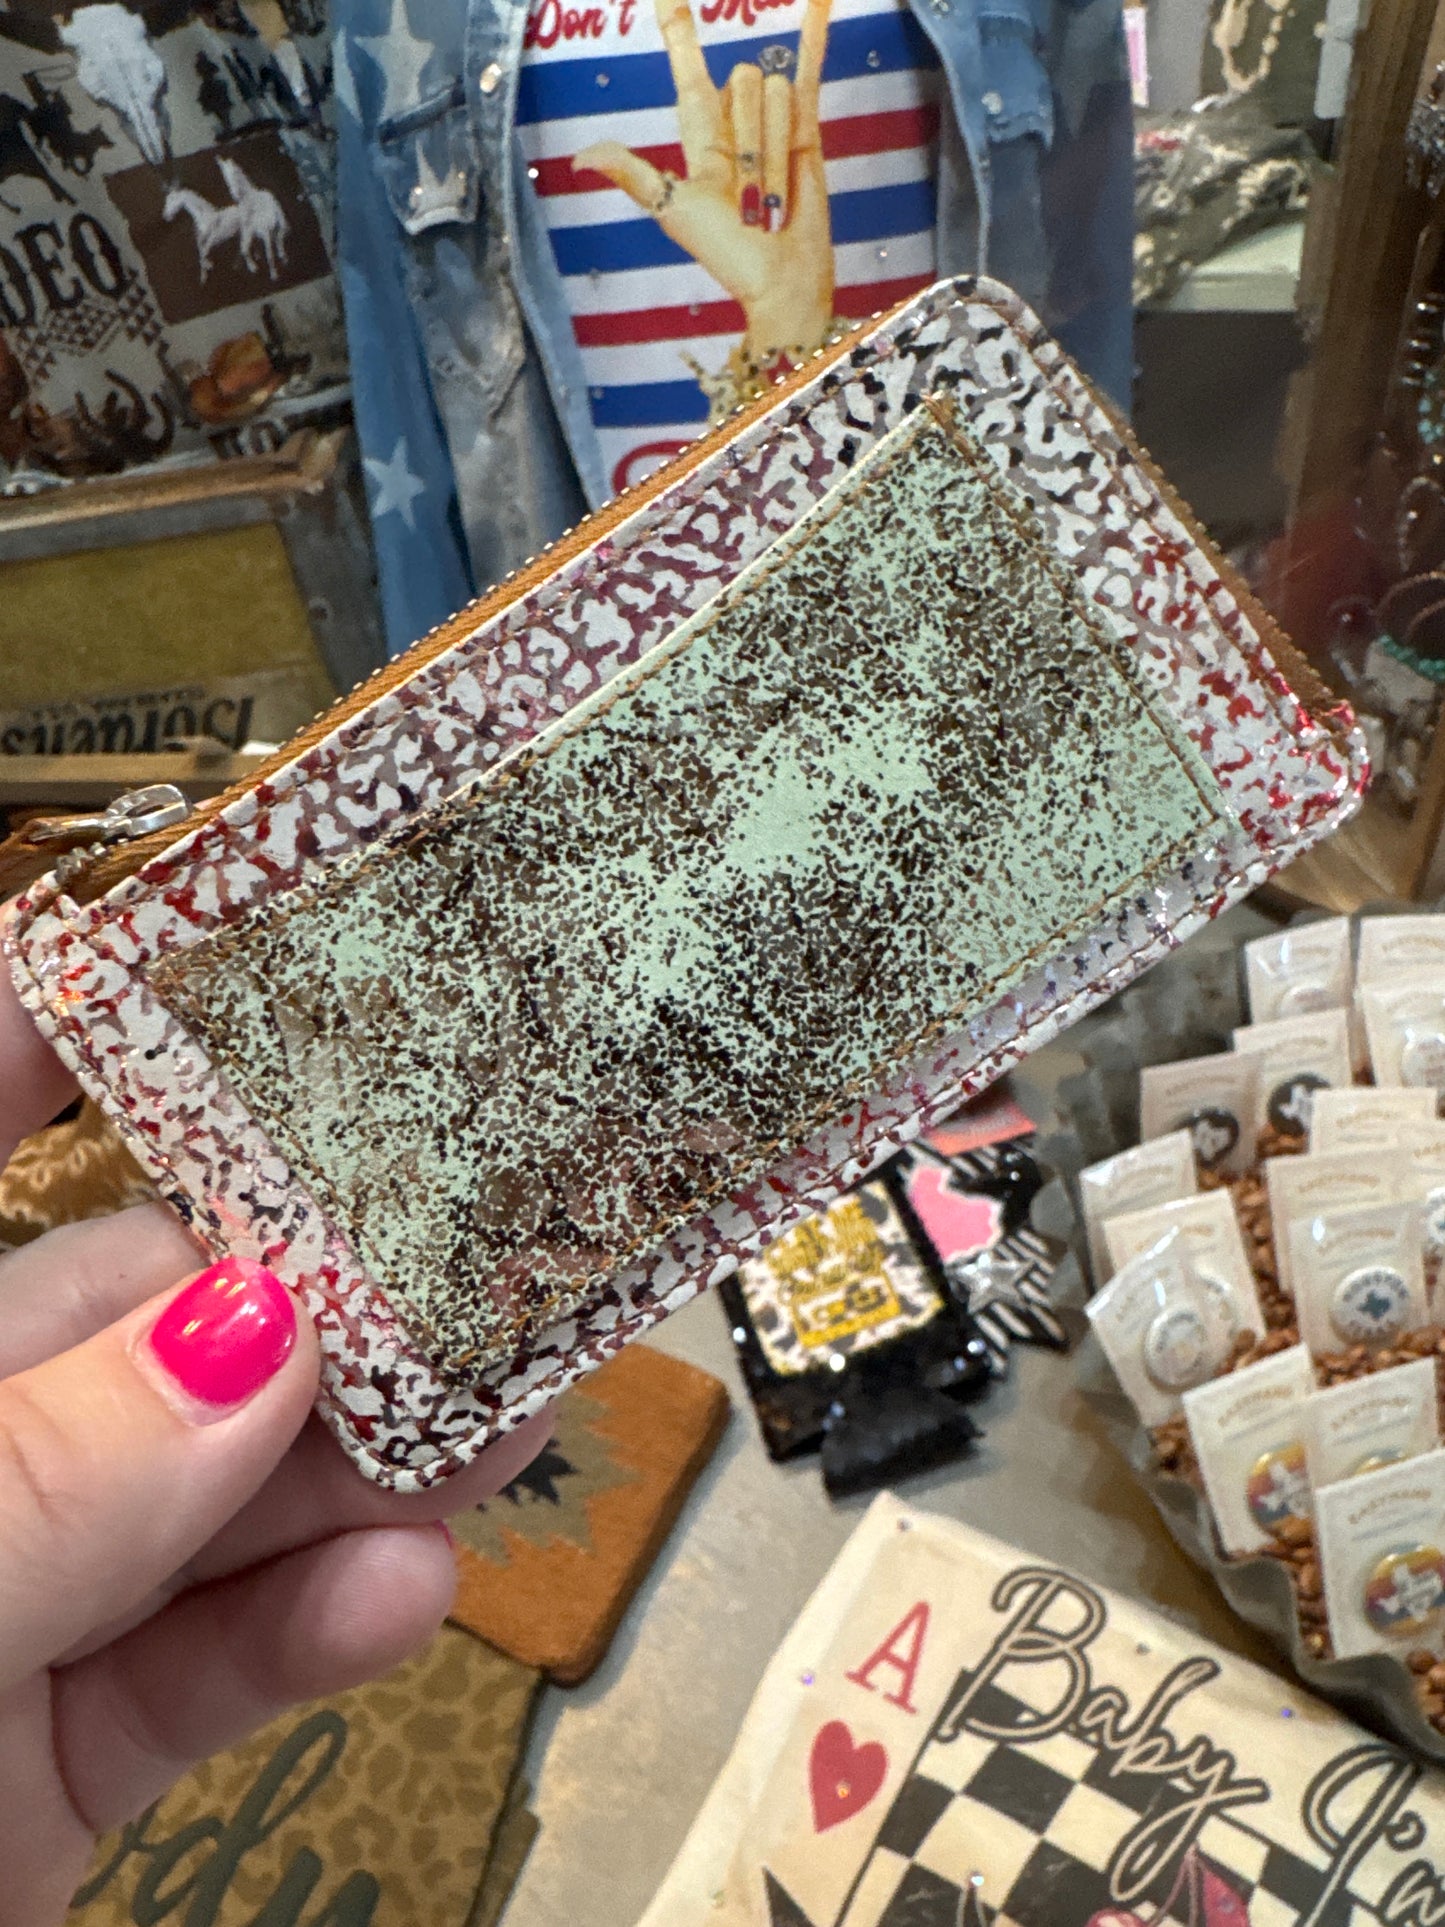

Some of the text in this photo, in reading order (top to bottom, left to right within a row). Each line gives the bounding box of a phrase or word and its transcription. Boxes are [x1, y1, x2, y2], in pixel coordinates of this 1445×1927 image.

[524, 0, 638, 49] Dont
[844, 1600, 932, 1715] A
[935, 1565, 1271, 1902] Baby
